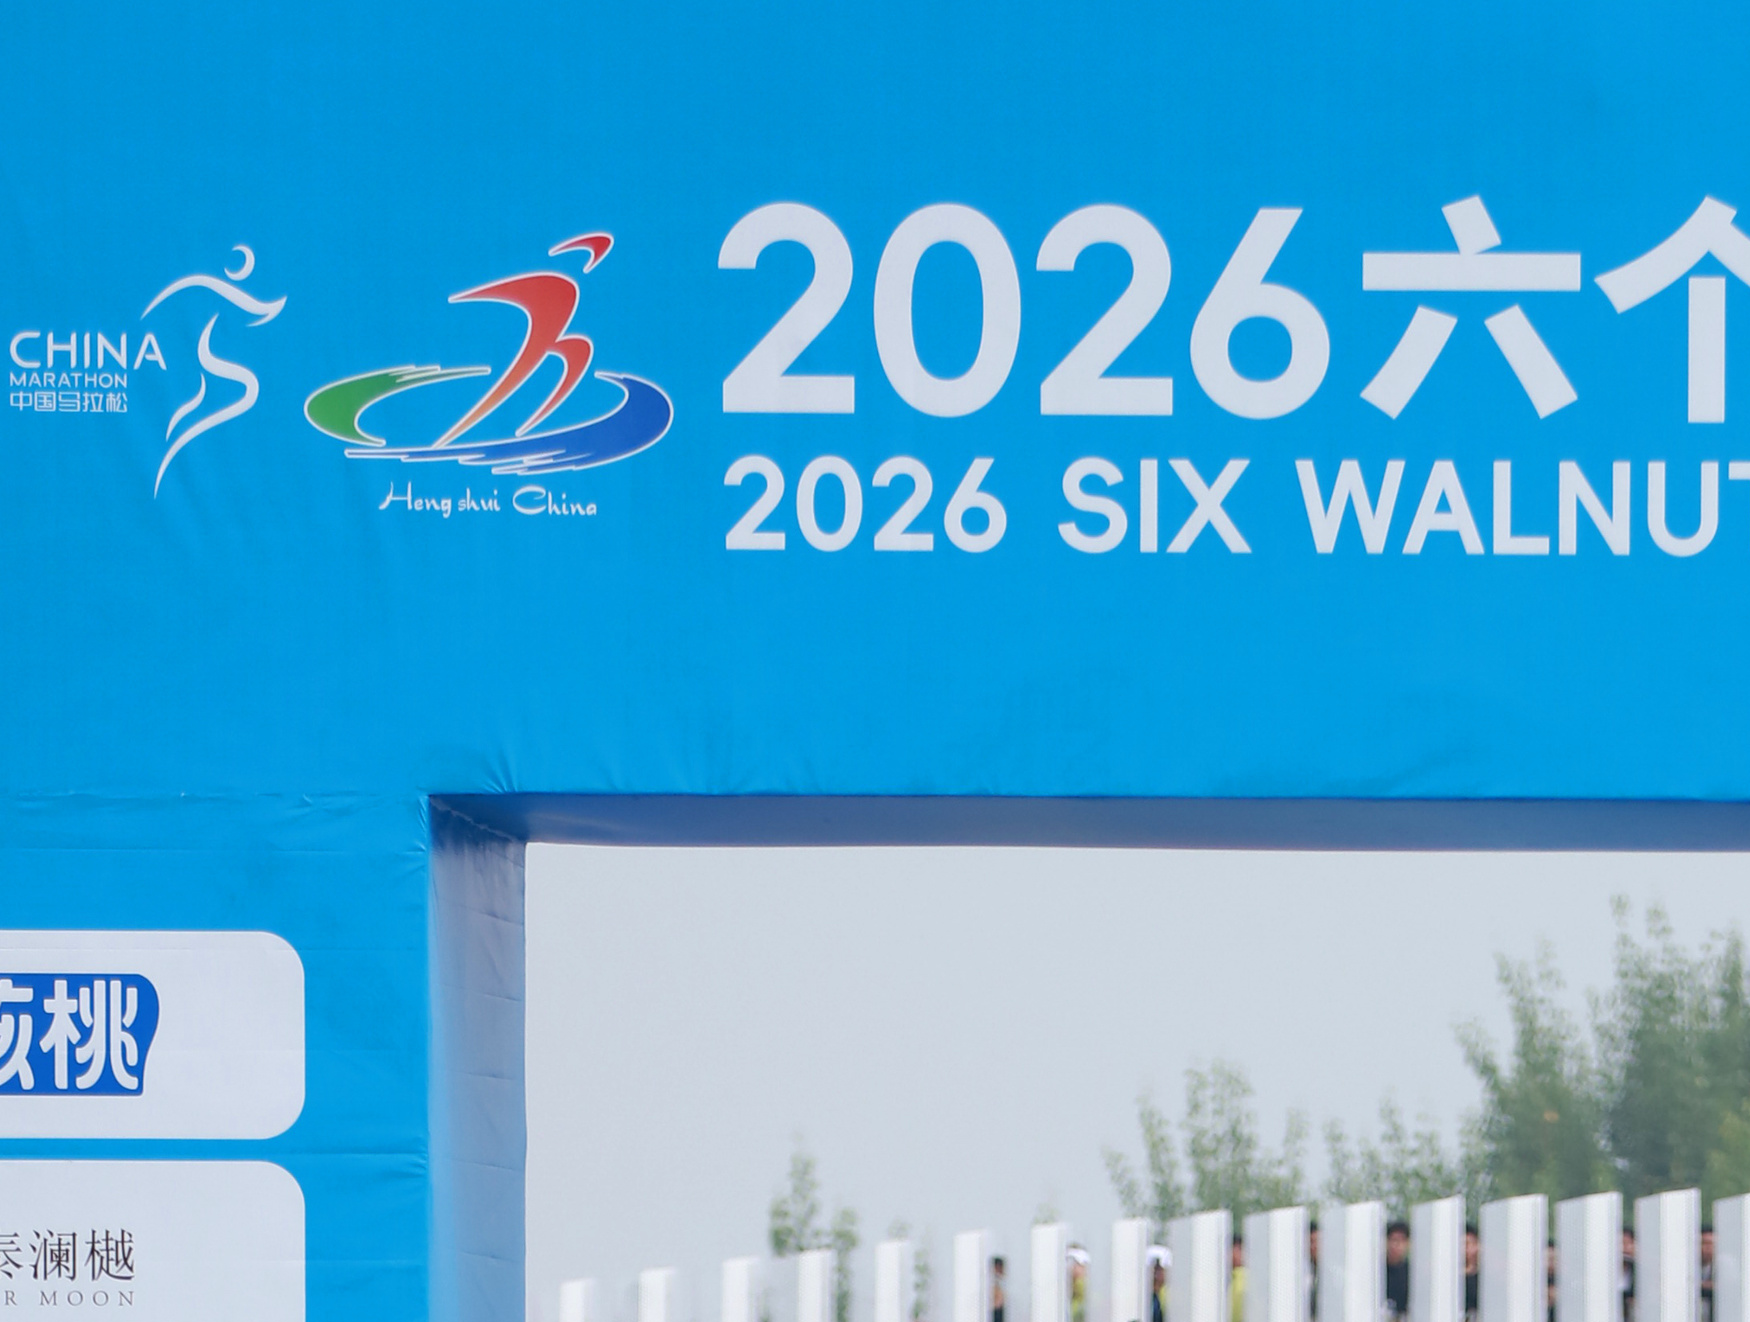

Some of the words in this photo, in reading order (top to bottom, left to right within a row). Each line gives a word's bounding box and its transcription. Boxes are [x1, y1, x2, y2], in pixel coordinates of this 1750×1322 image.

[9, 331, 167, 371] CHINA
[9, 373, 128, 388] MARATHON
[9, 391, 128, 413] 中国马拉松
[379, 482, 452, 518] Heng
[513, 486, 597, 517] China
[722, 455, 1008, 554] 2026
[1057, 457, 1252, 555] SIX
[40, 1290, 134, 1306] MOON
